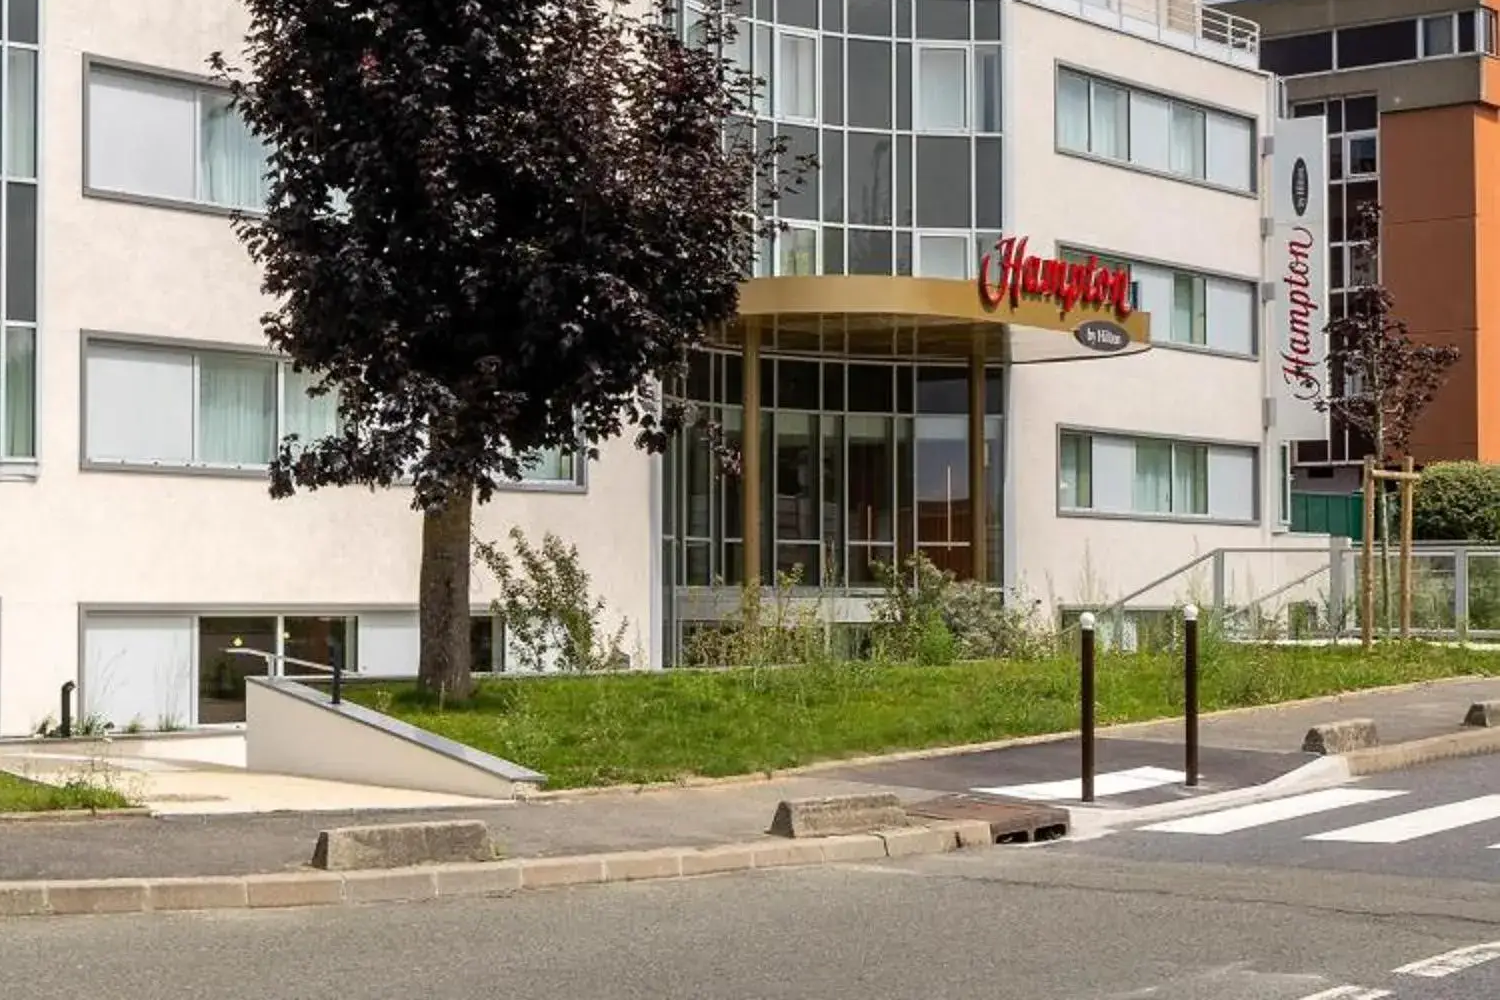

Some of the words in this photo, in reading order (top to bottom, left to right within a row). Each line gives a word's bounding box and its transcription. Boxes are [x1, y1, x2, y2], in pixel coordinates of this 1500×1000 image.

[979, 236, 1132, 320] Hampton
[1280, 227, 1320, 400] Hampton
[1087, 327, 1097, 345] by
[1097, 329, 1121, 345] Hilton
